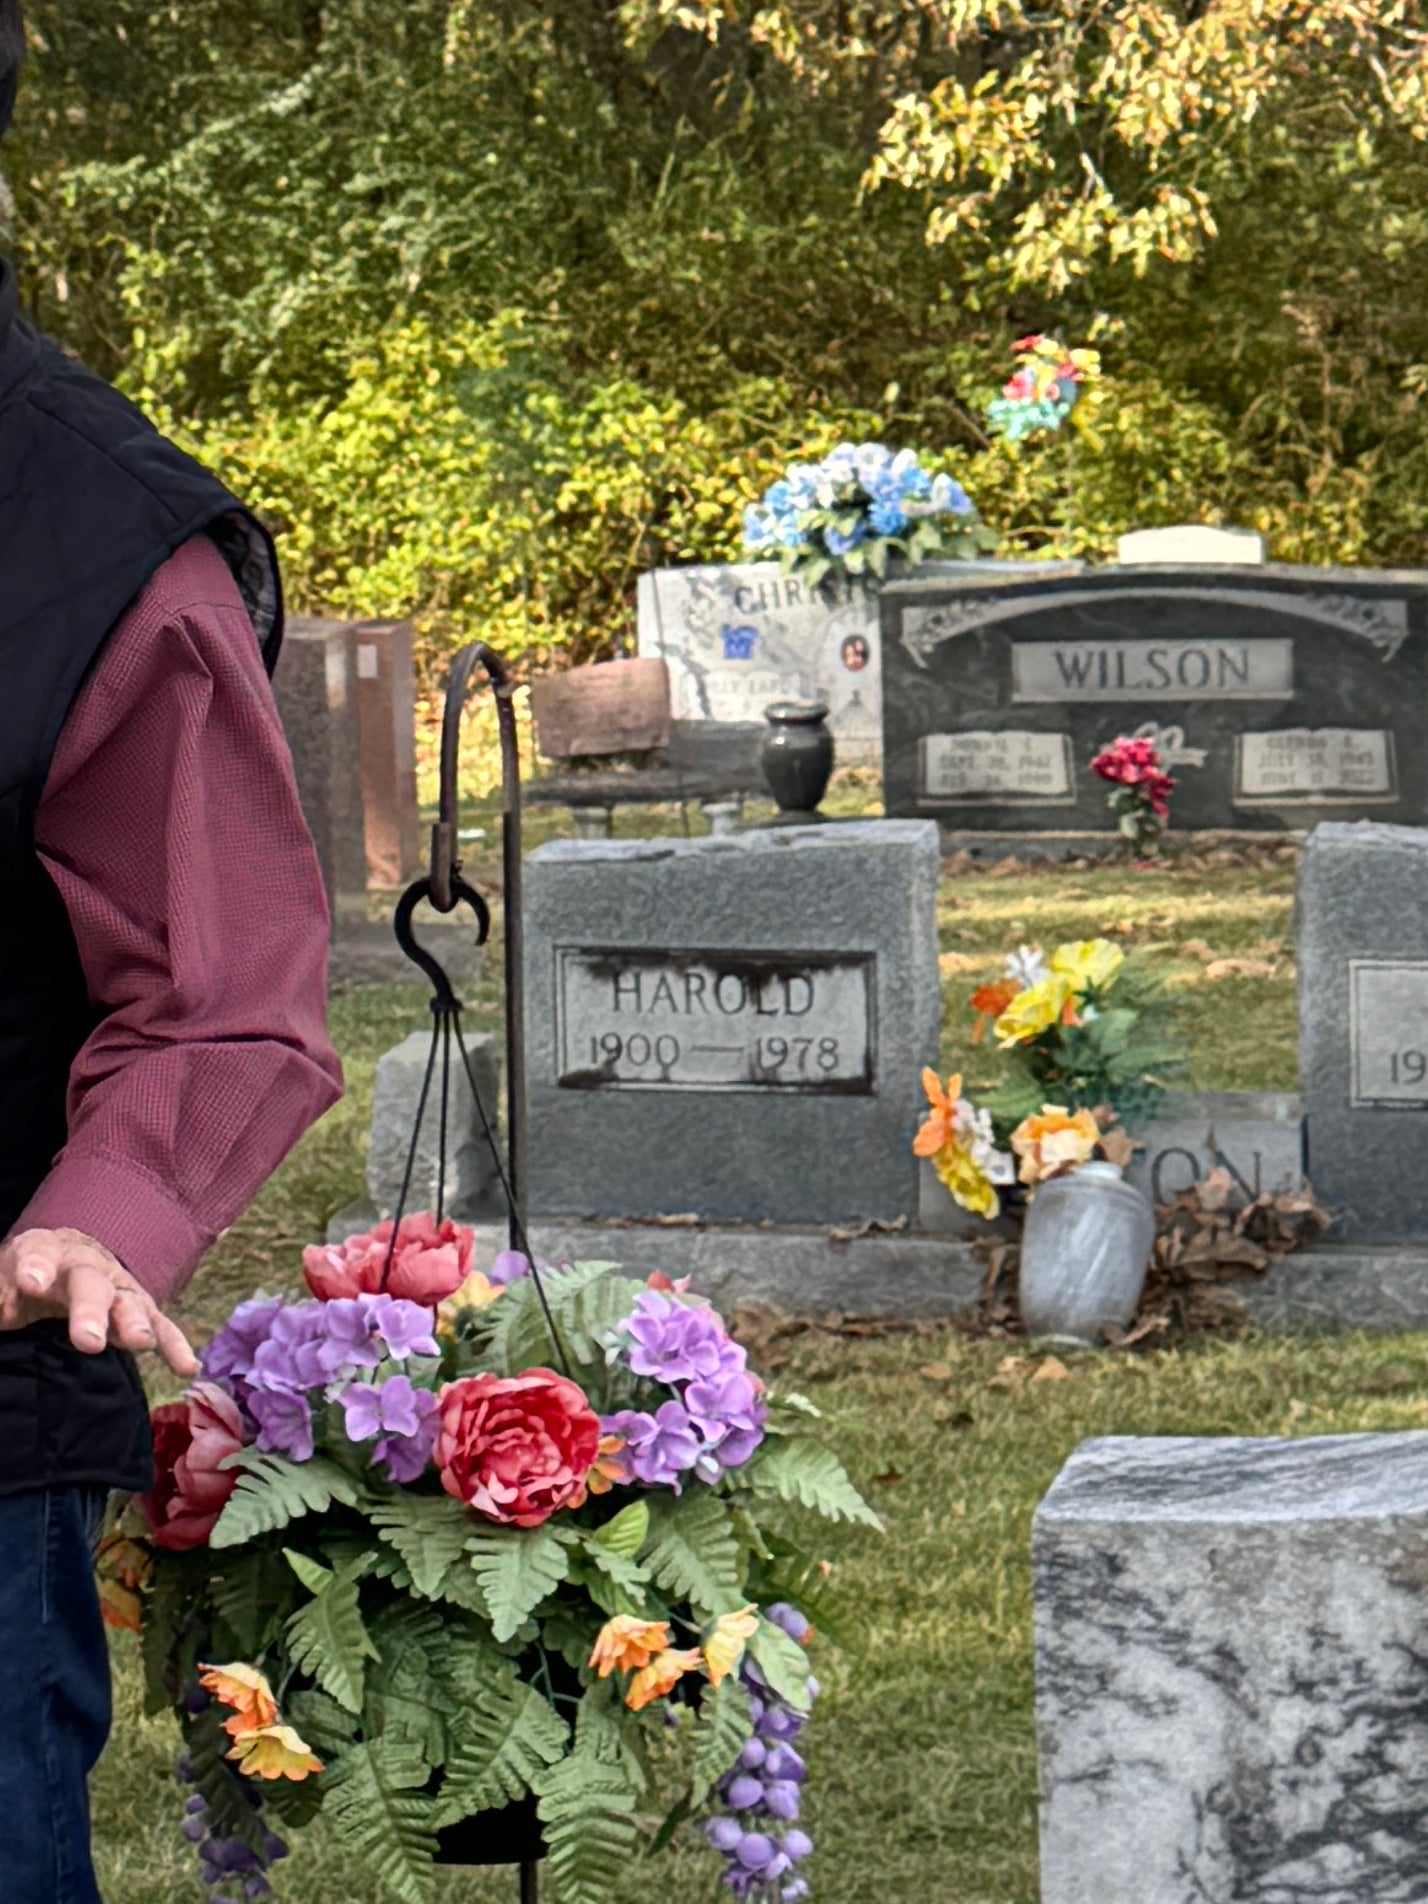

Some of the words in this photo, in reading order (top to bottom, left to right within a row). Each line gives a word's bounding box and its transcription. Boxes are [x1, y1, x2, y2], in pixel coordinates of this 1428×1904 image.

[1054, 647, 1249, 689] WILSON
[612, 972, 816, 1016] HAROLD
[590, 1031, 680, 1067] 1900
[755, 1036, 840, 1072] 1978
